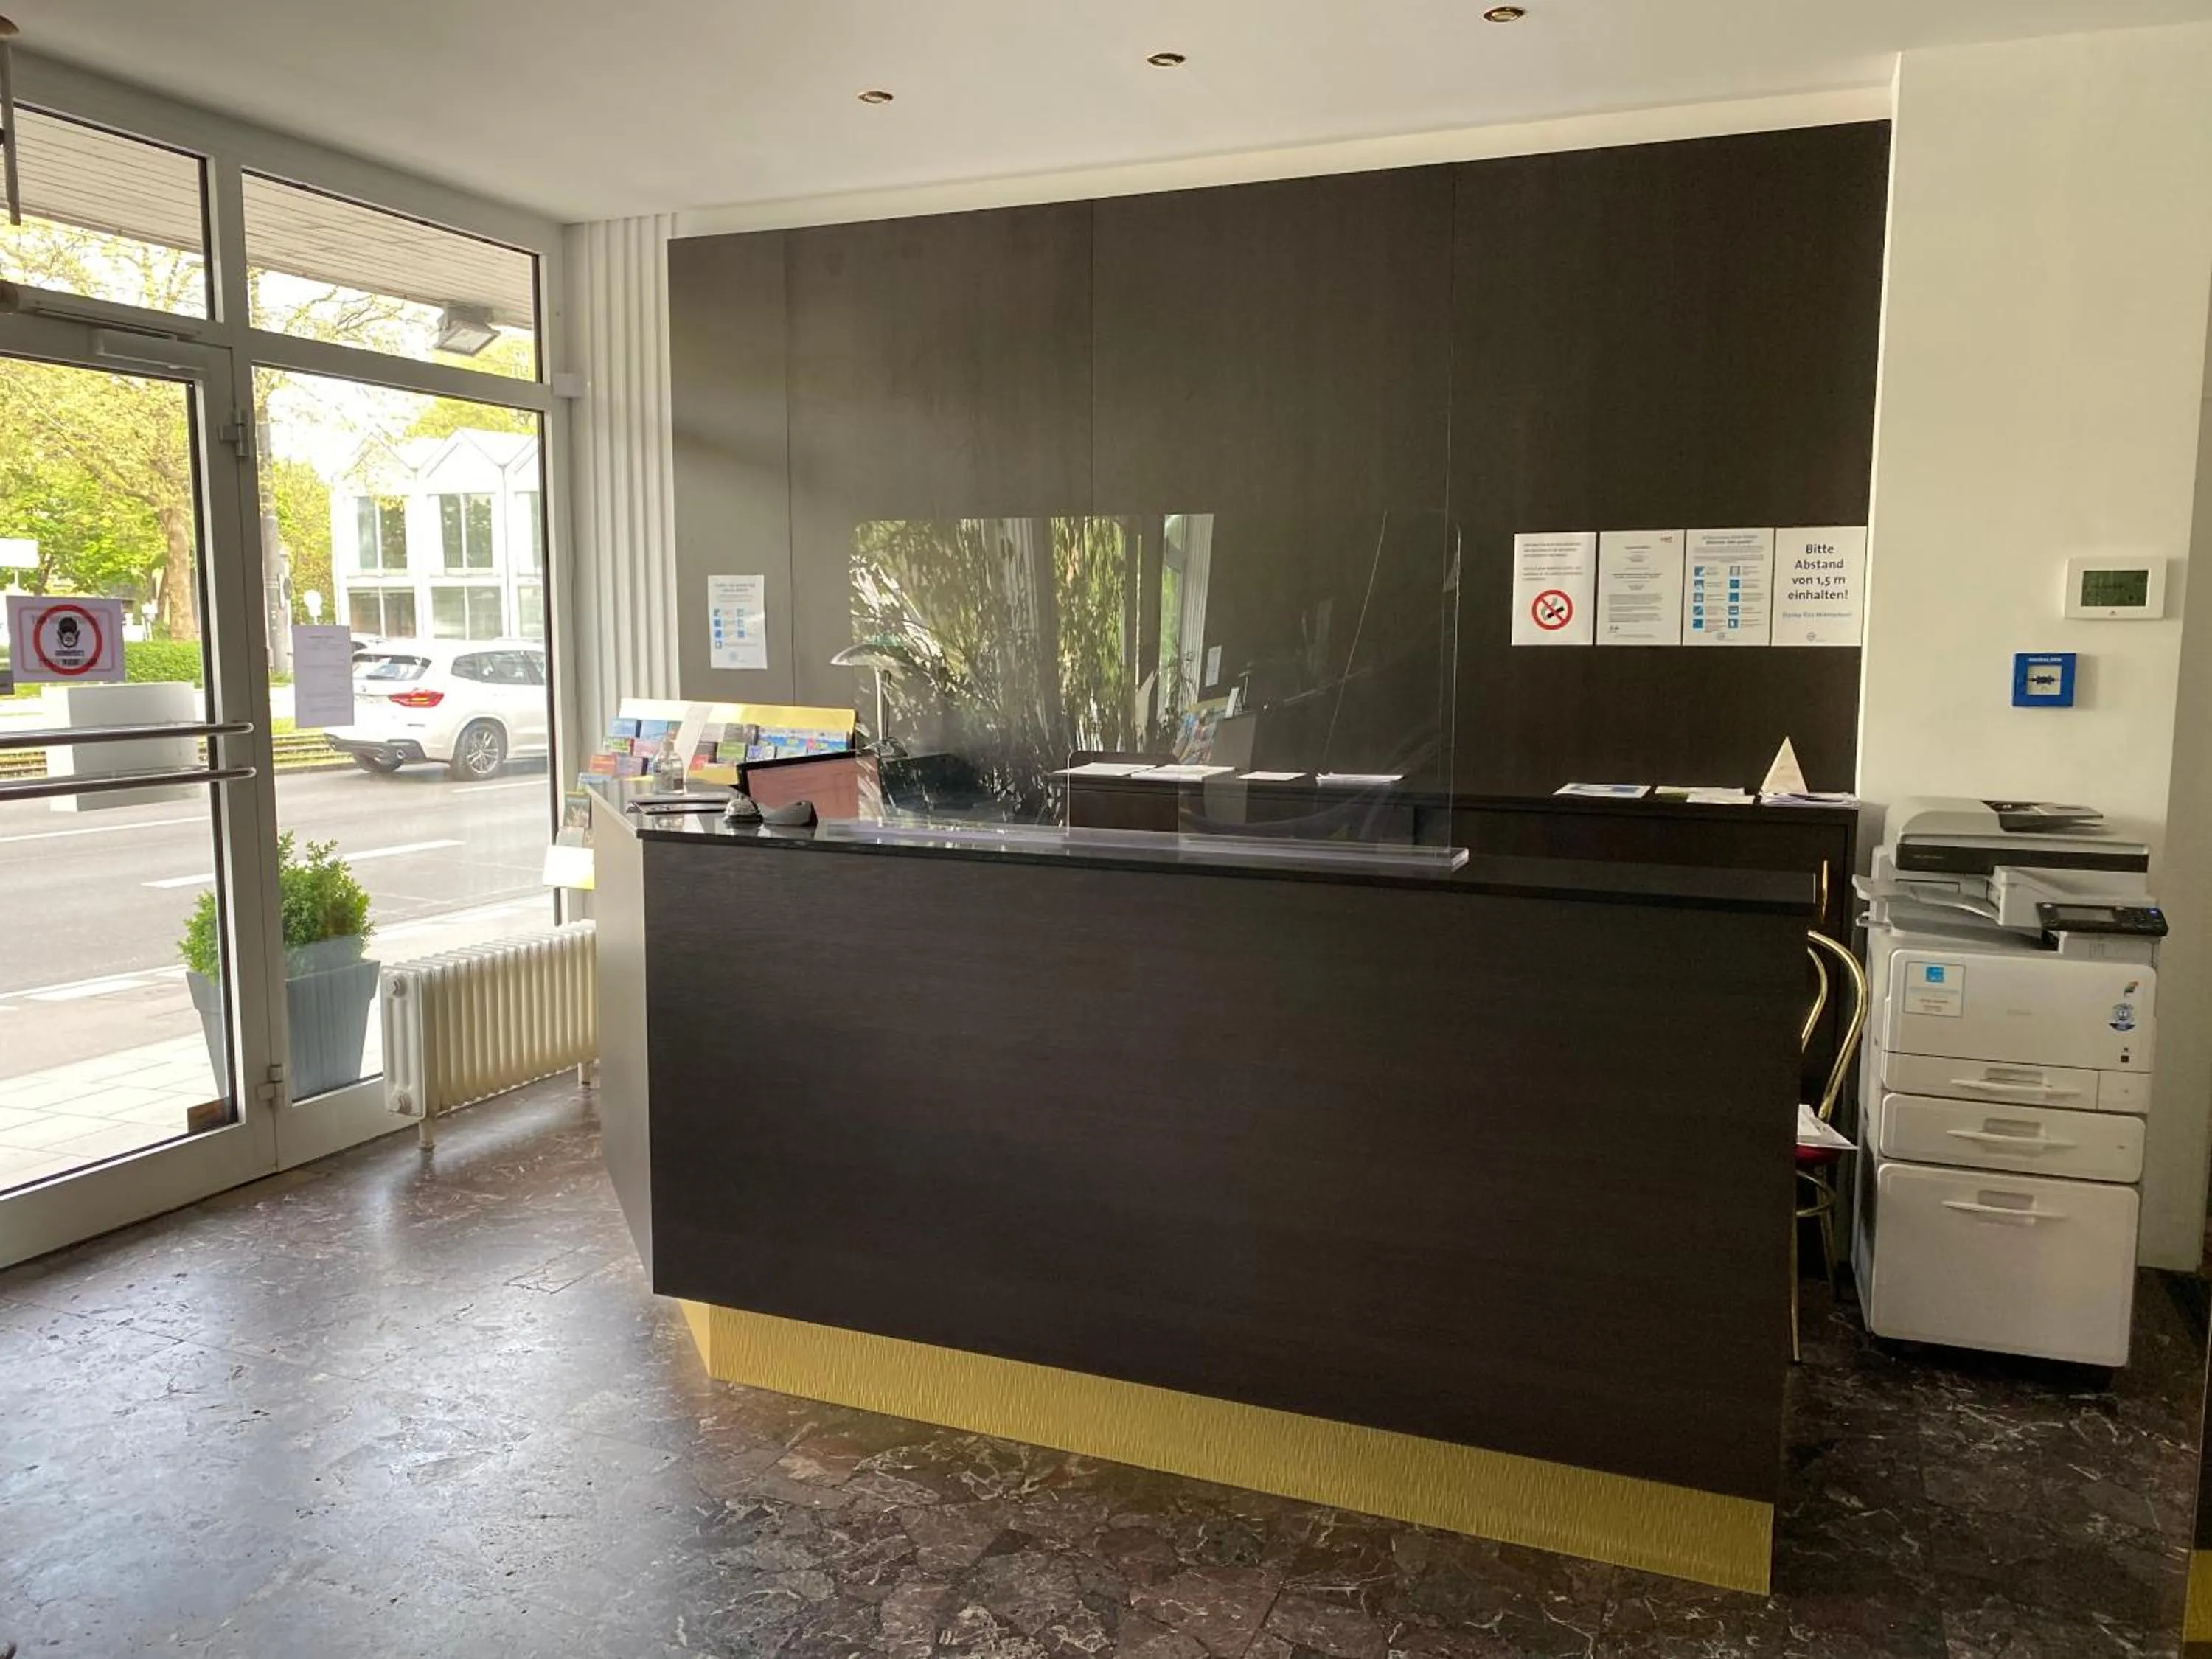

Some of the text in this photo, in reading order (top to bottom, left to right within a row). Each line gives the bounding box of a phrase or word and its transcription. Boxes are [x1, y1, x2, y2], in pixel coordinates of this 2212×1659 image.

[1806, 544, 1834, 554] Bitte
[1794, 558, 1844, 569] Abstand
[1792, 576, 1846, 586] von 1,5 m
[1787, 590, 1848, 599] einhalten!
